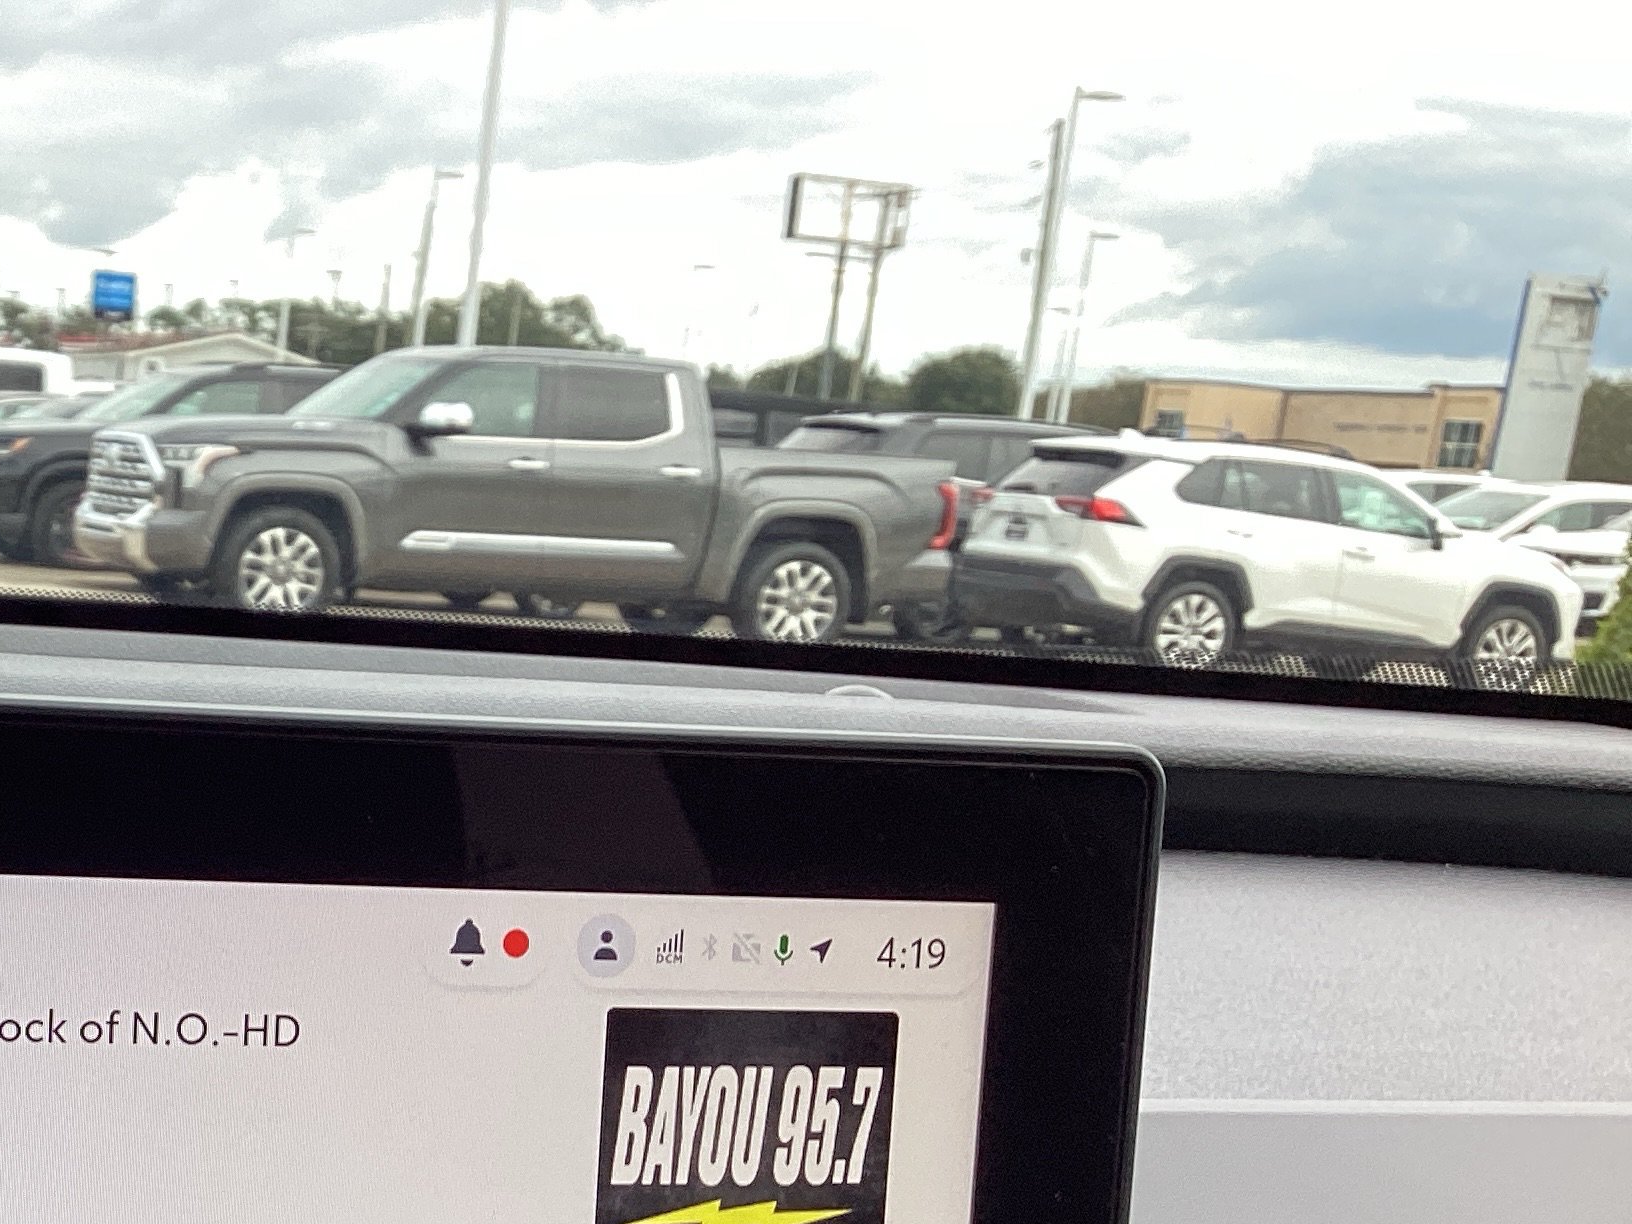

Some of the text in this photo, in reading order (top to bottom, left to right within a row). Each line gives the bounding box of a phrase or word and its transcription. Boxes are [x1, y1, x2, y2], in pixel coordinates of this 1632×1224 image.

[655, 951, 685, 965] DCM
[877, 938, 945, 968] 4:19
[80, 1010, 120, 1044] of
[133, 1012, 299, 1046] N.O.-HD
[610, 1065, 883, 1186] BAYOU 95.7
